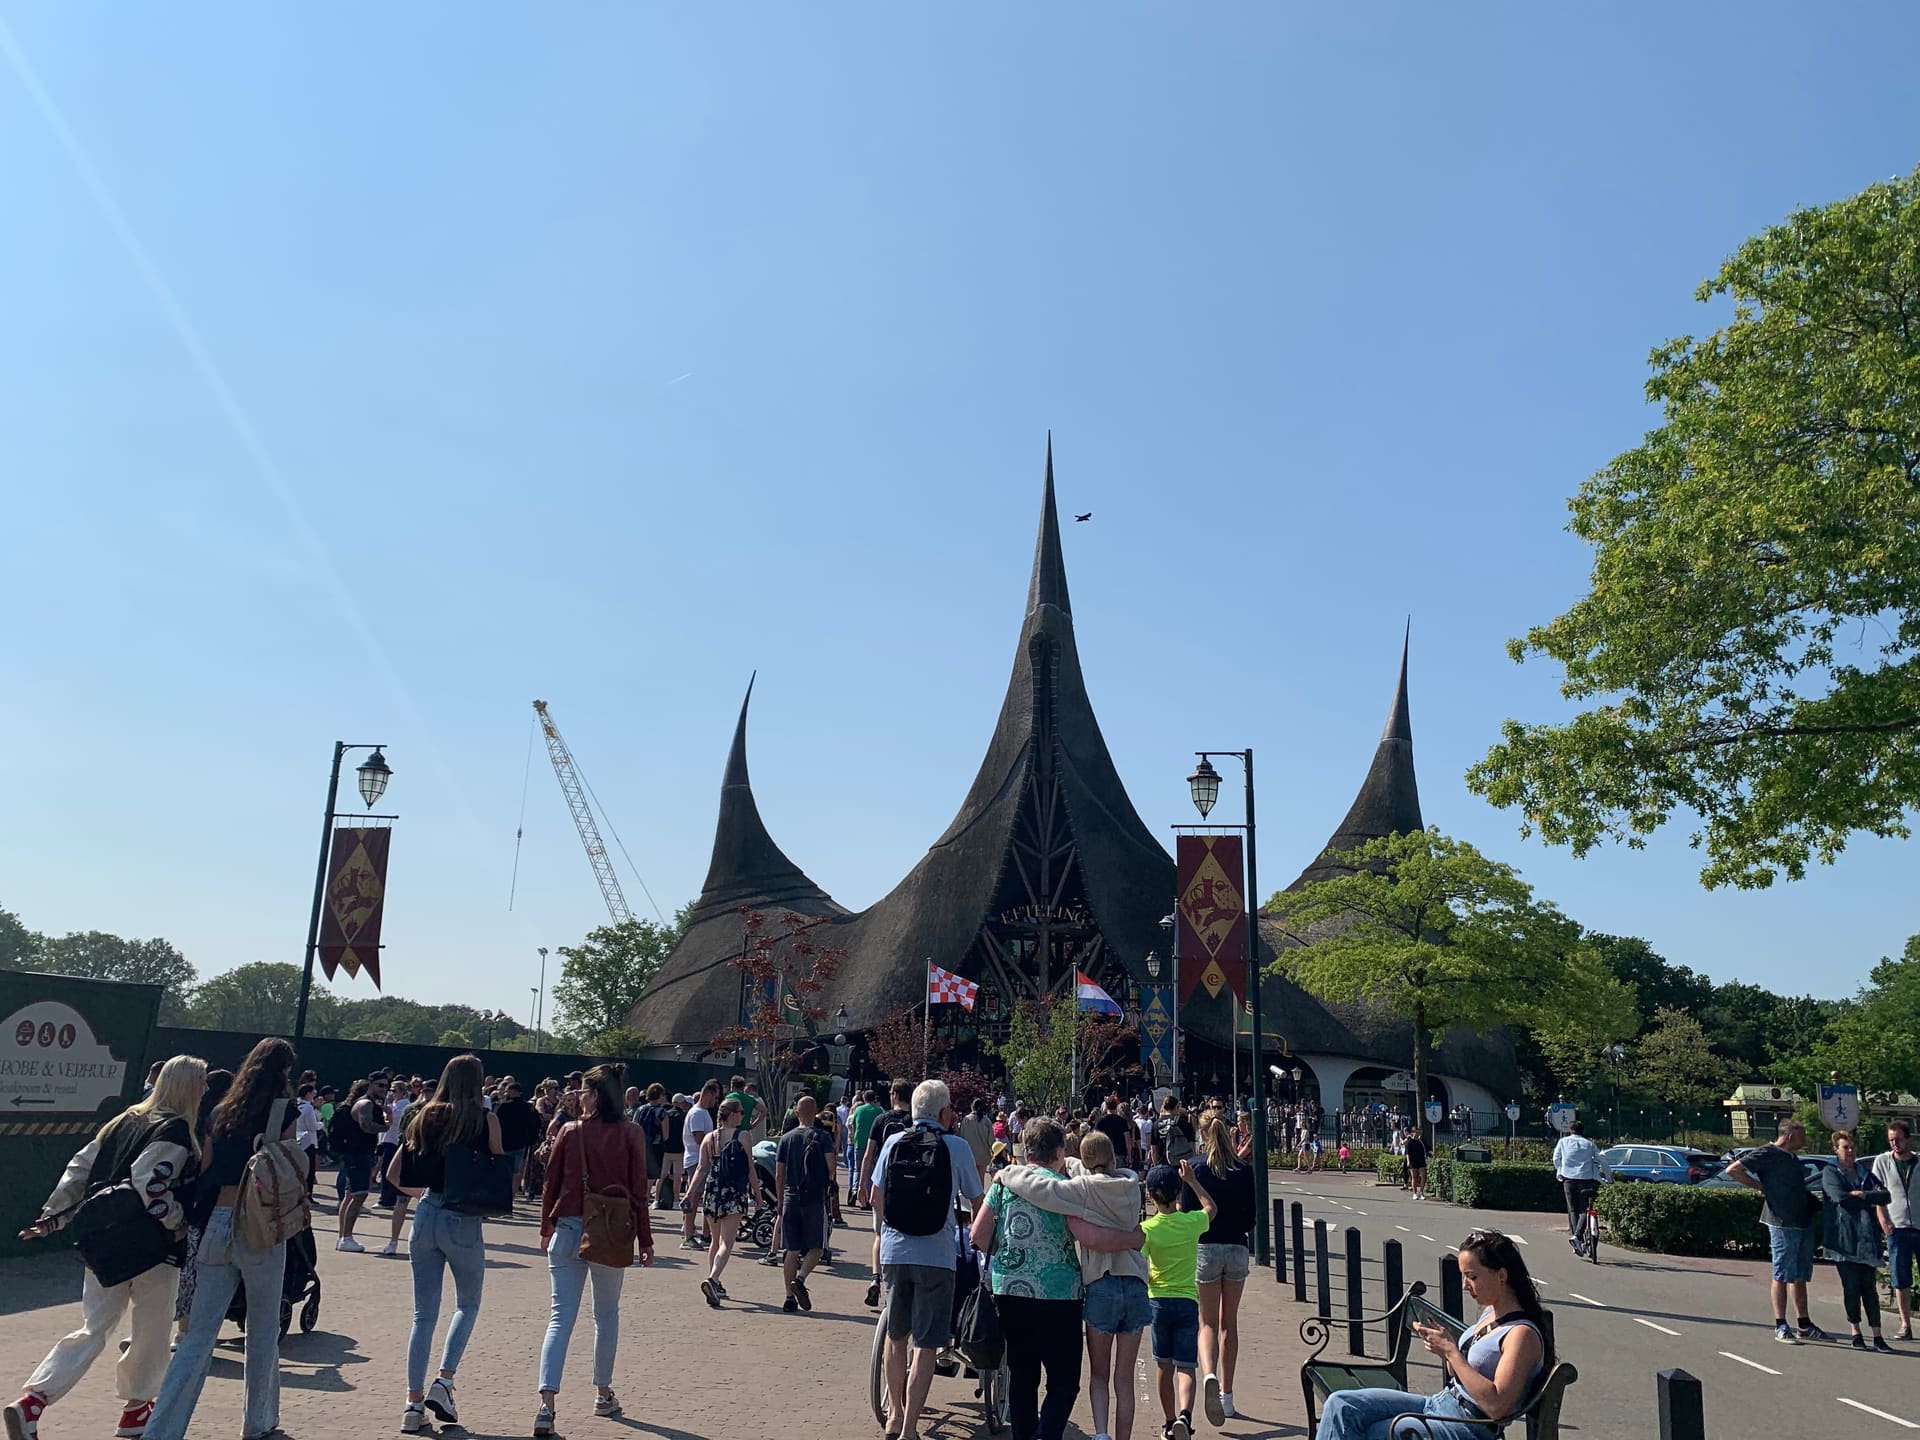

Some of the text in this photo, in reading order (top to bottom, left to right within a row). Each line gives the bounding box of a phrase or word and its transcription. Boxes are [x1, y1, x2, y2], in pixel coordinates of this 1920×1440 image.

[0, 1059, 117, 1079] ROBE & VERHUUR
